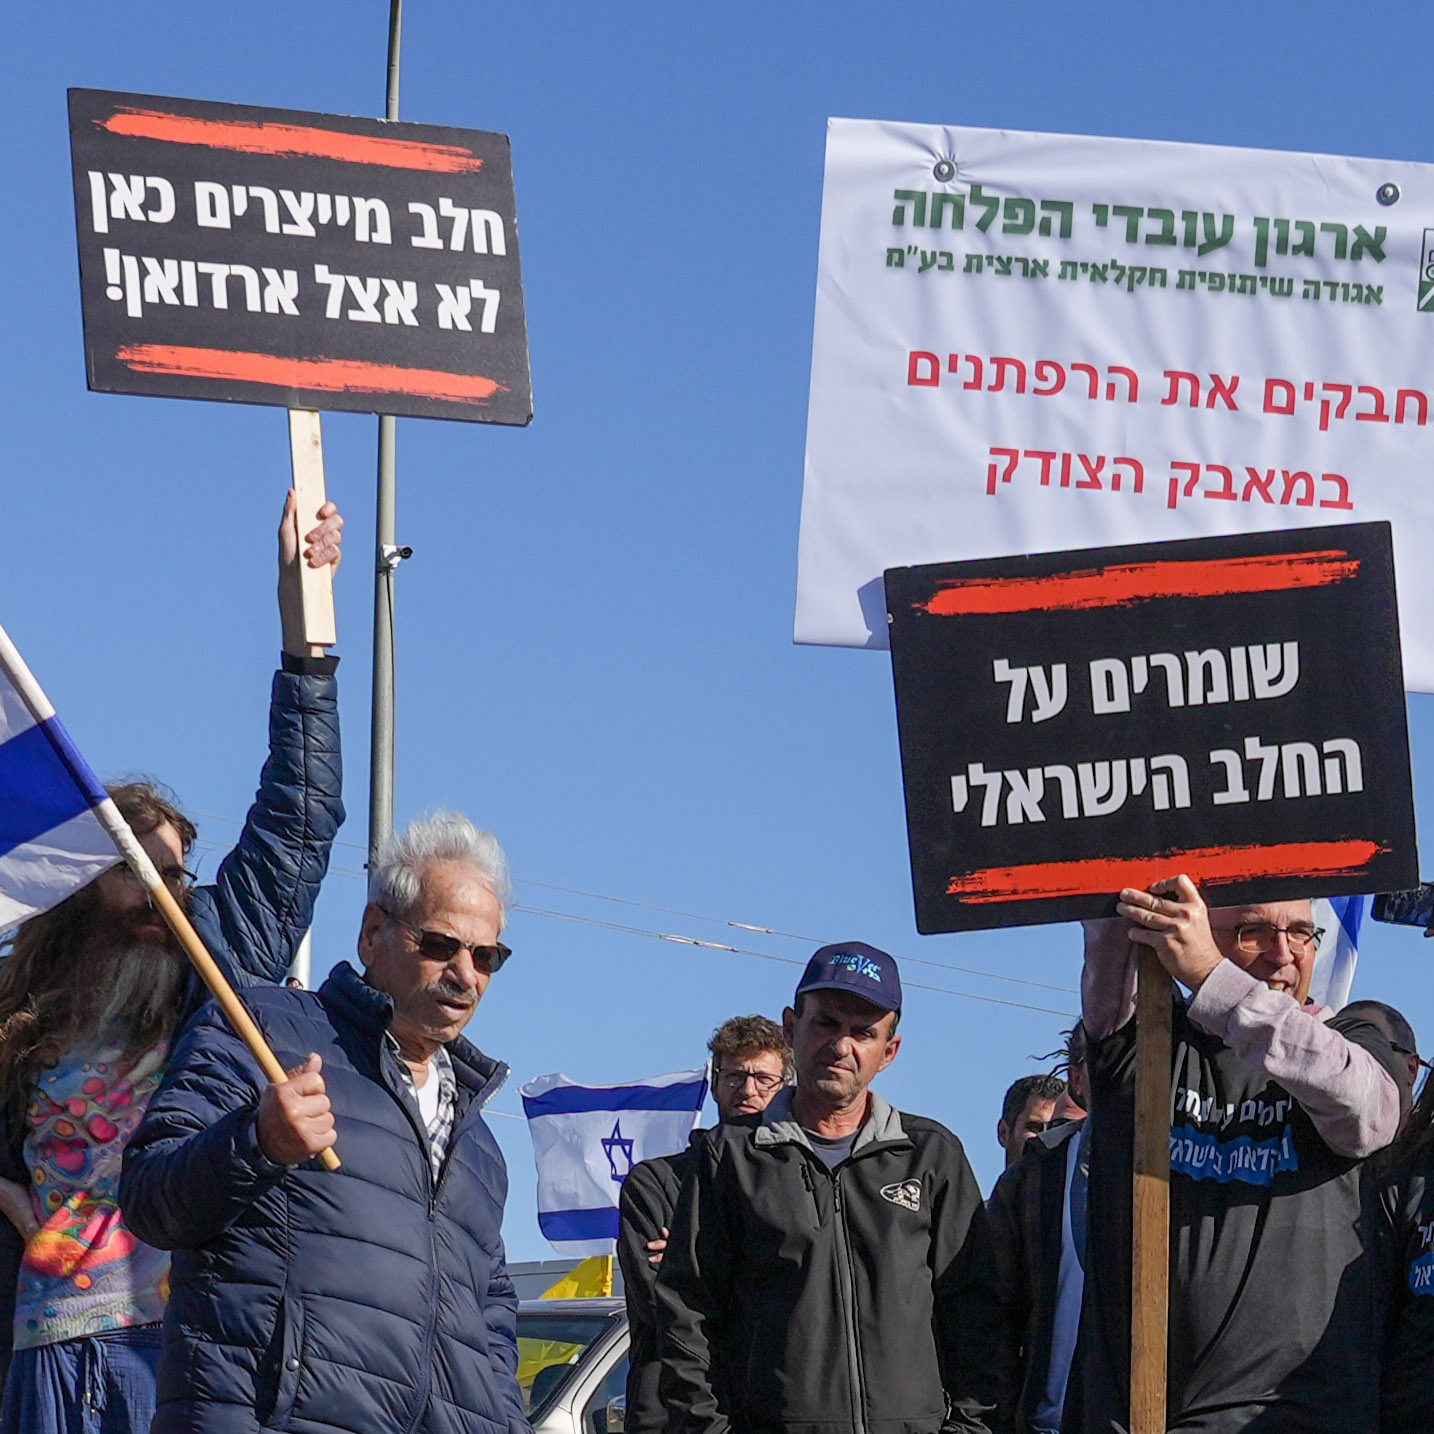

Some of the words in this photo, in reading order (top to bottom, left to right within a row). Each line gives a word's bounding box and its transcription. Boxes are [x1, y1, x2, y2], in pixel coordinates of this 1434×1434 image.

[88, 170, 176, 233] כאן
[194, 181, 392, 244] מייצרים
[410, 198, 507, 256] חלב
[892, 184, 1074, 239] הפלחה
[1092, 202, 1235, 257] עובדי
[1253, 215, 1388, 268] ארגון
[103, 248, 300, 318] ארדואן!
[963, 251, 1050, 279] ארצית
[1058, 259, 1168, 293] חקלאית
[1176, 269, 1294, 299] שיתופית
[1302, 279, 1385, 306] אגודה
[315, 264, 419, 326] אצל
[437, 278, 501, 334] לא
[907, 350, 1139, 403] הרפתנים
[1161, 369, 1241, 412] את
[986, 446, 1144, 496] הצודק
[1167, 460, 1354, 511] במאבק
[992, 658, 1068, 724] על
[1089, 640, 1300, 716] שומרים
[950, 753, 1192, 828] הישראלי
[1208, 736, 1364, 806] החלב
